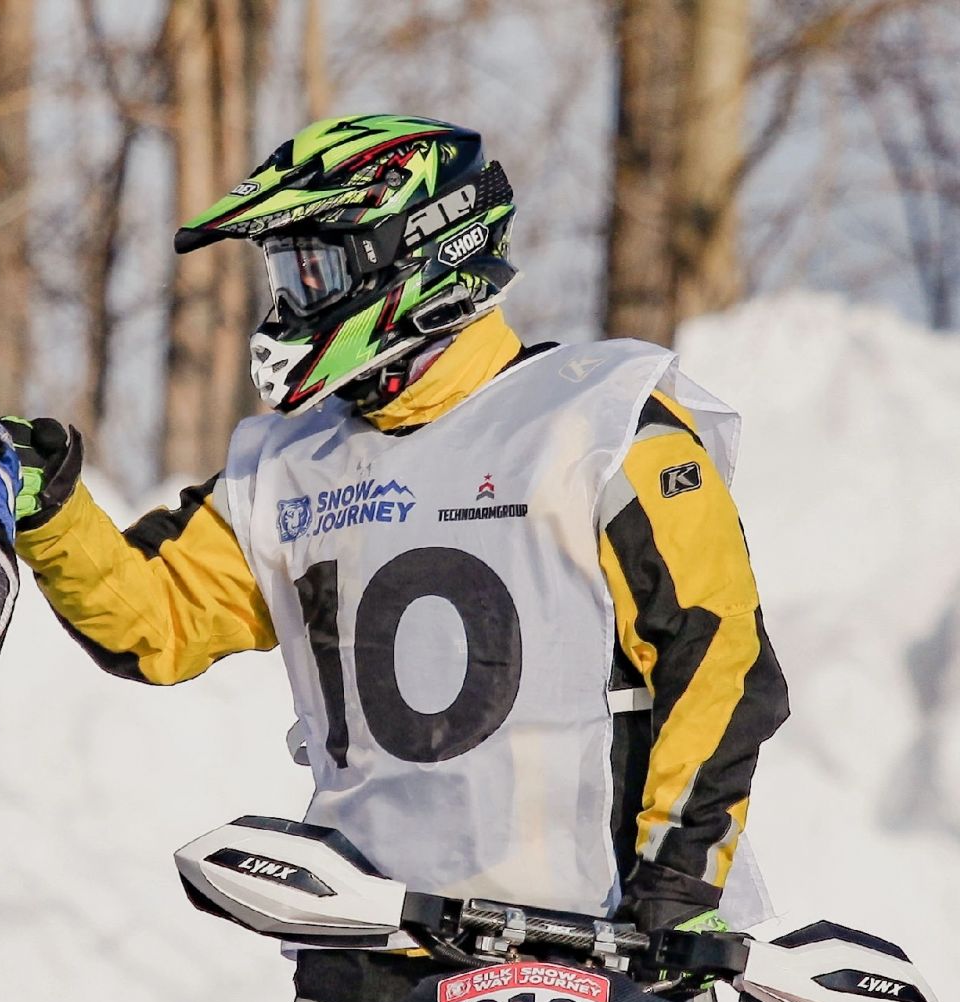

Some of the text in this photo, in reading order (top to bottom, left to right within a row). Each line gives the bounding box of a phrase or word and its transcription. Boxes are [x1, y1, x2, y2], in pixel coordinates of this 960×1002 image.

[444, 226, 484, 261] SHOEI
[317, 479, 375, 513] SNOW
[313, 501, 417, 536] JOURNEY
[438, 504, 528, 522] TECHNOARMGROUP
[294, 546, 523, 768] 10
[238, 857, 298, 880] LYNX
[472, 967, 513, 985] SILK
[473, 974, 514, 992] WAY
[520, 967, 575, 981] SNOW
[517, 975, 602, 997] JOURNEY
[857, 976, 906, 997] LYNX
